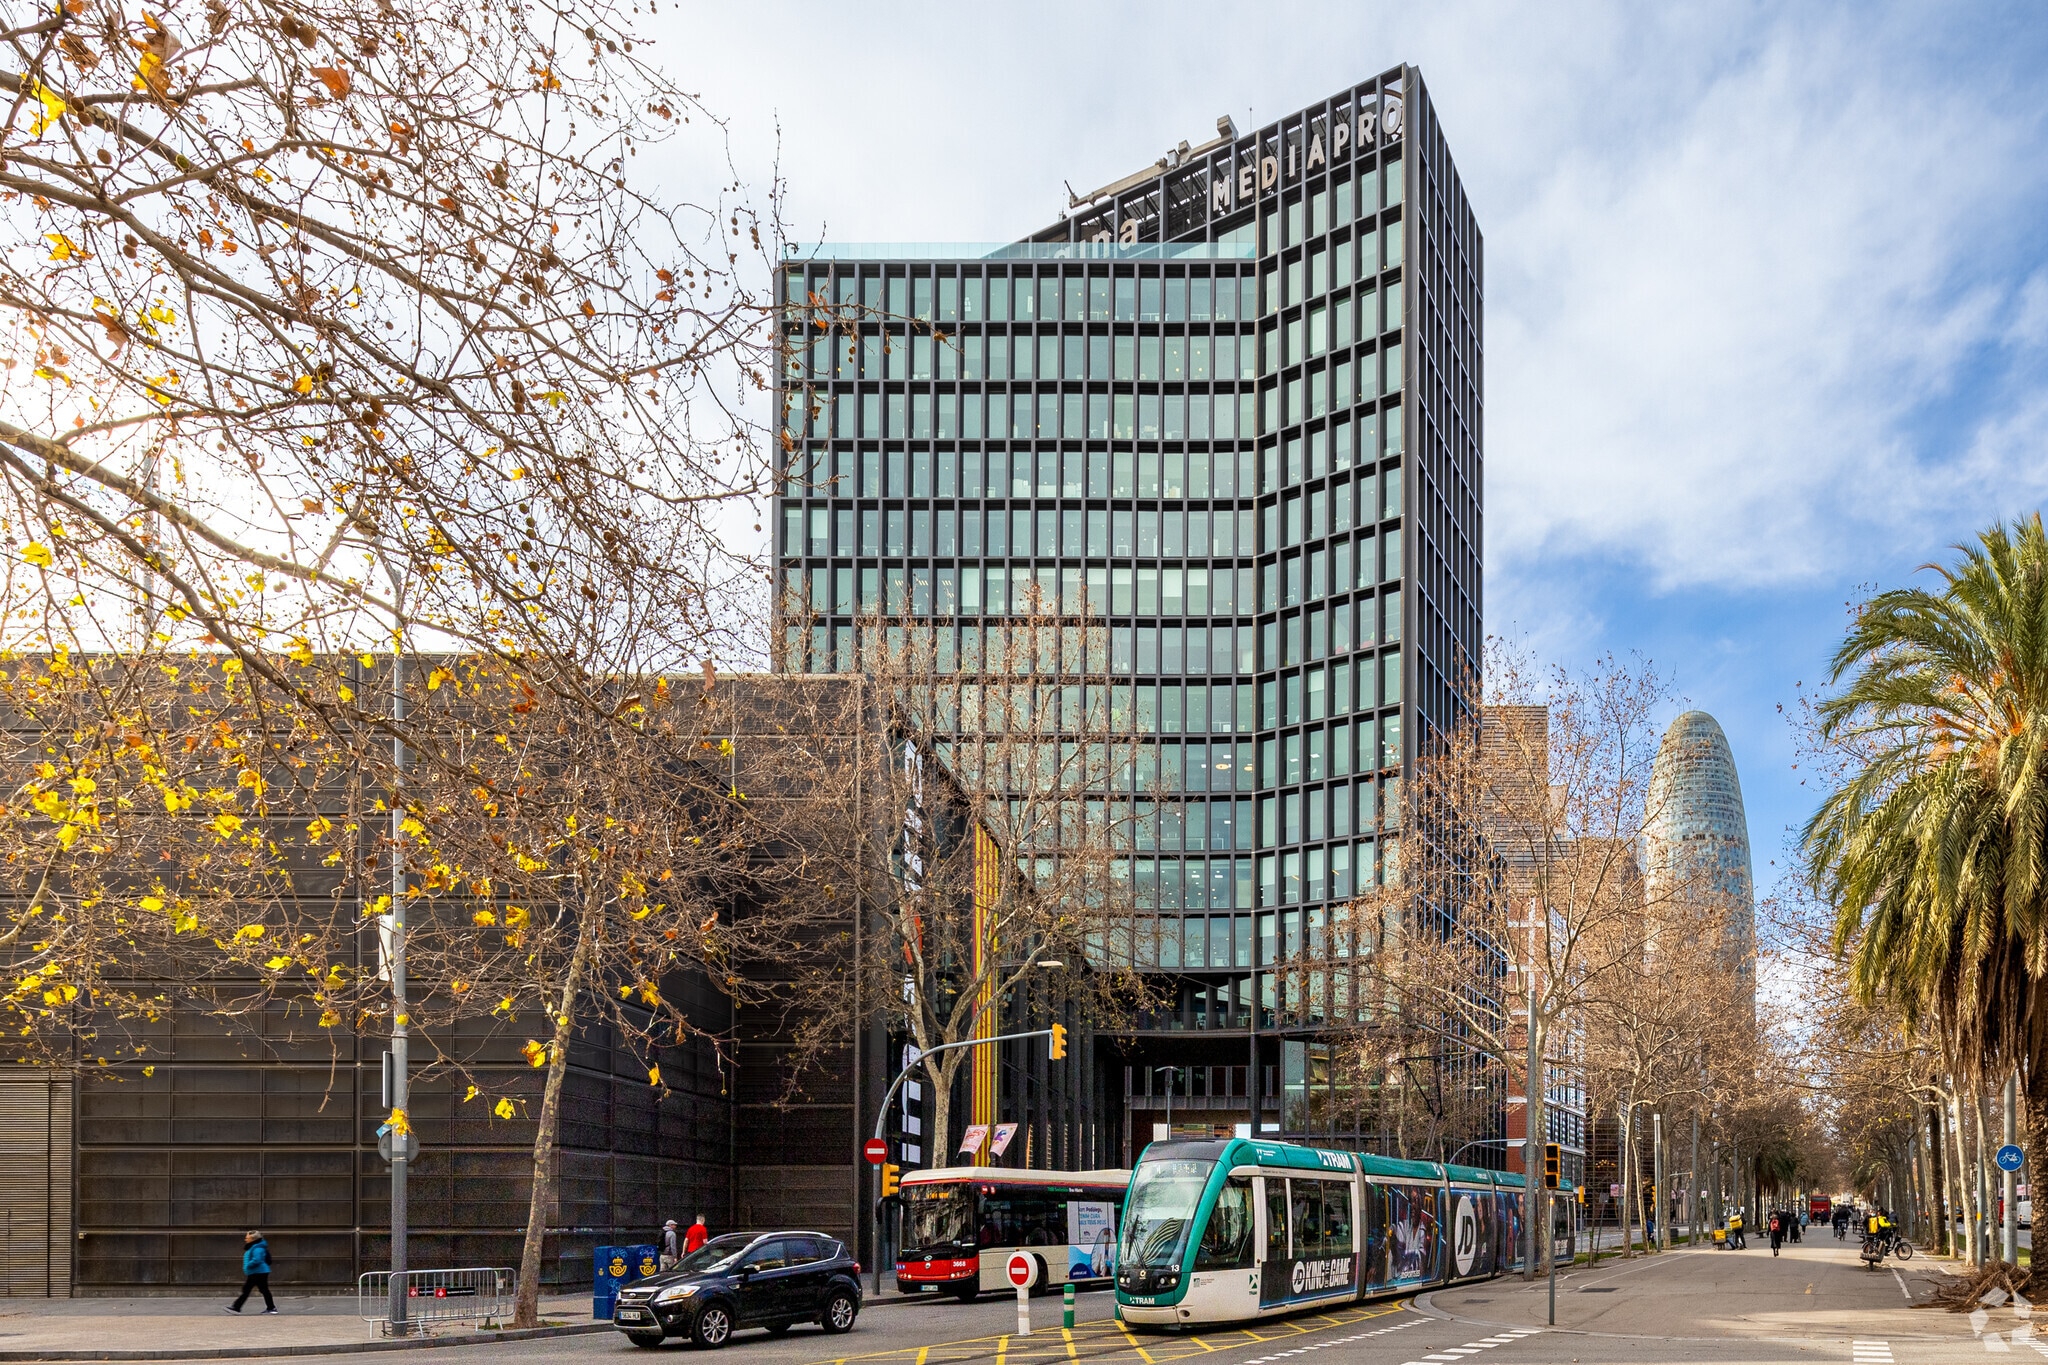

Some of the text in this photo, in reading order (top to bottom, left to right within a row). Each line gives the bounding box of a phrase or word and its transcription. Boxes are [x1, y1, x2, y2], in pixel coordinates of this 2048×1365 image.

[1212, 99, 1403, 211] MEDIAPRO
[1327, 1152, 1352, 1170] TRAM
[1457, 1215, 1474, 1255] JD
[1170, 1264, 1180, 1272] 13
[1305, 1259, 1325, 1291] KING
[1329, 1257, 1351, 1288] GAME
[1135, 1297, 1155, 1305] TRAM
